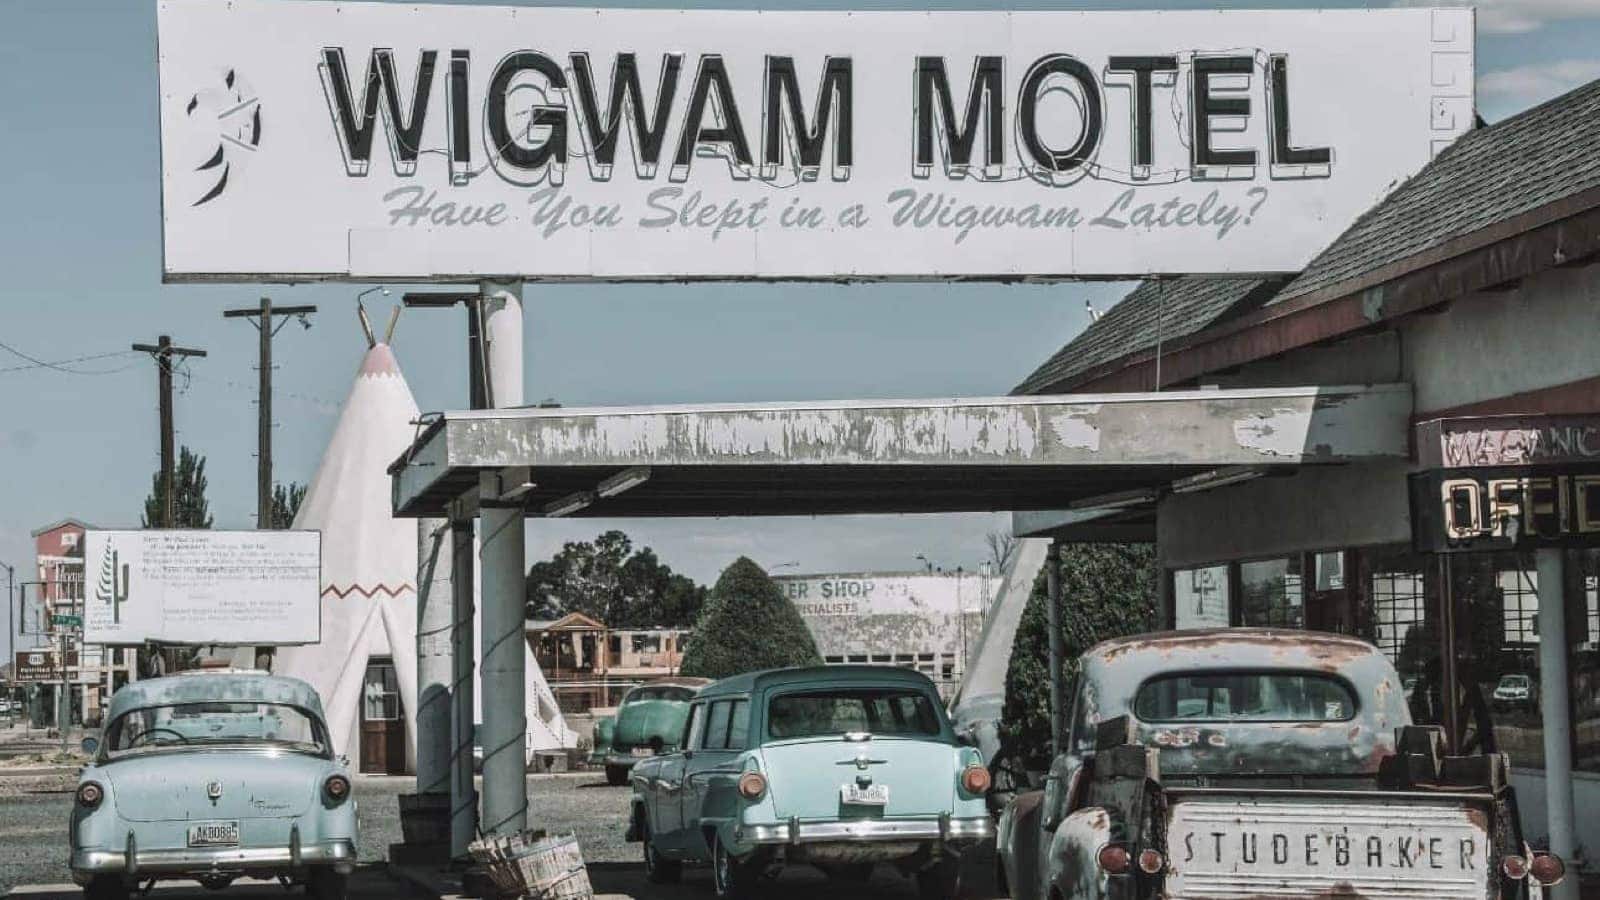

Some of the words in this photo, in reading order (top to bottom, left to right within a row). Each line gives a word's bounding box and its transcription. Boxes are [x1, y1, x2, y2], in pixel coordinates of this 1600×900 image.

[317, 46, 854, 186] WIGWAM
[911, 47, 1336, 187] MOTEL
[383, 185, 508, 228] Have
[527, 185, 624, 240] You
[639, 186, 769, 242] Slept
[779, 187, 824, 229] in
[837, 203, 869, 228] a
[886, 188, 1084, 244] Wigwam
[1089, 187, 1268, 240] Lately?
[822, 580, 874, 598] SHOP
[1184, 830, 1475, 870] STUDEBAKER
